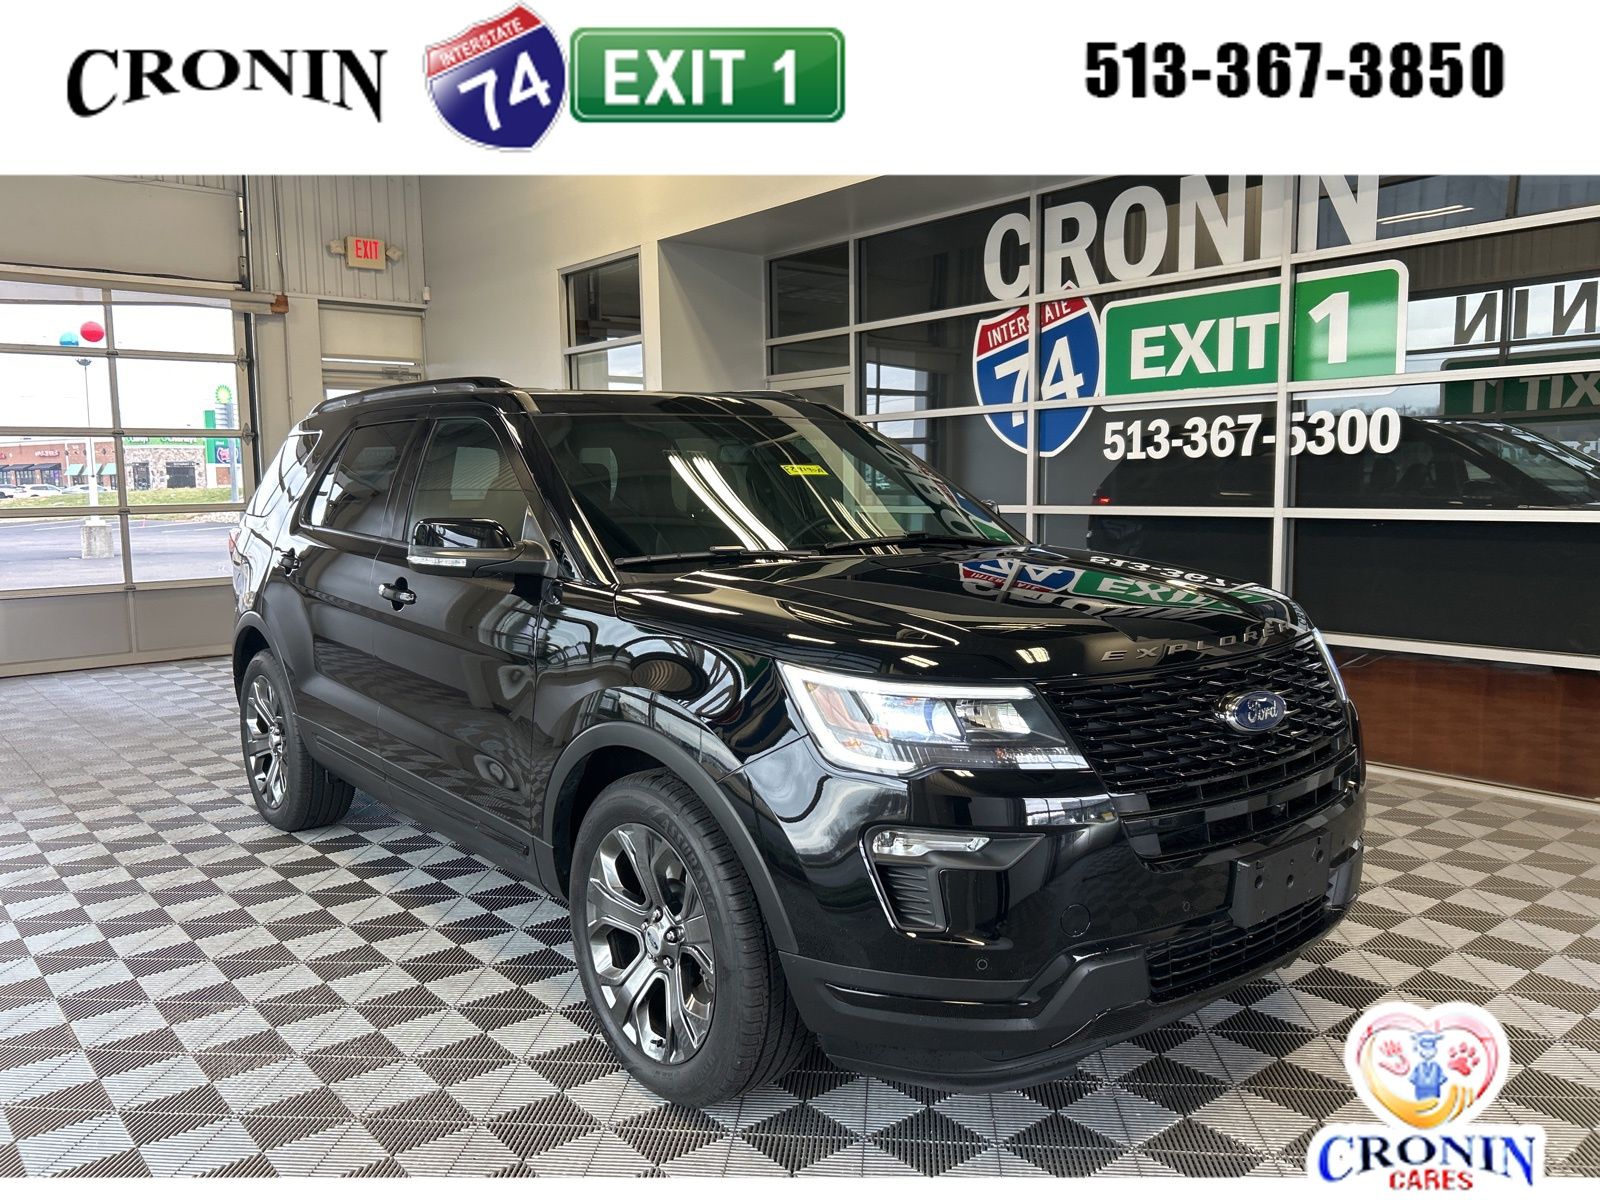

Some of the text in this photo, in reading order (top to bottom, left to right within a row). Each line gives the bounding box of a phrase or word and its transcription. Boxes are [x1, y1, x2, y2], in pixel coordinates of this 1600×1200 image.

[355, 239, 379, 260] EXIT
[983, 174, 1380, 300] CRONIN
[1130, 291, 1349, 380] EXIT 1
[994, 336, 1084, 428] 74
[1103, 407, 1401, 461] 513-367-5300
[1101, 620, 1289, 662] EXPLORER
[1247, 697, 1278, 724] Ford
